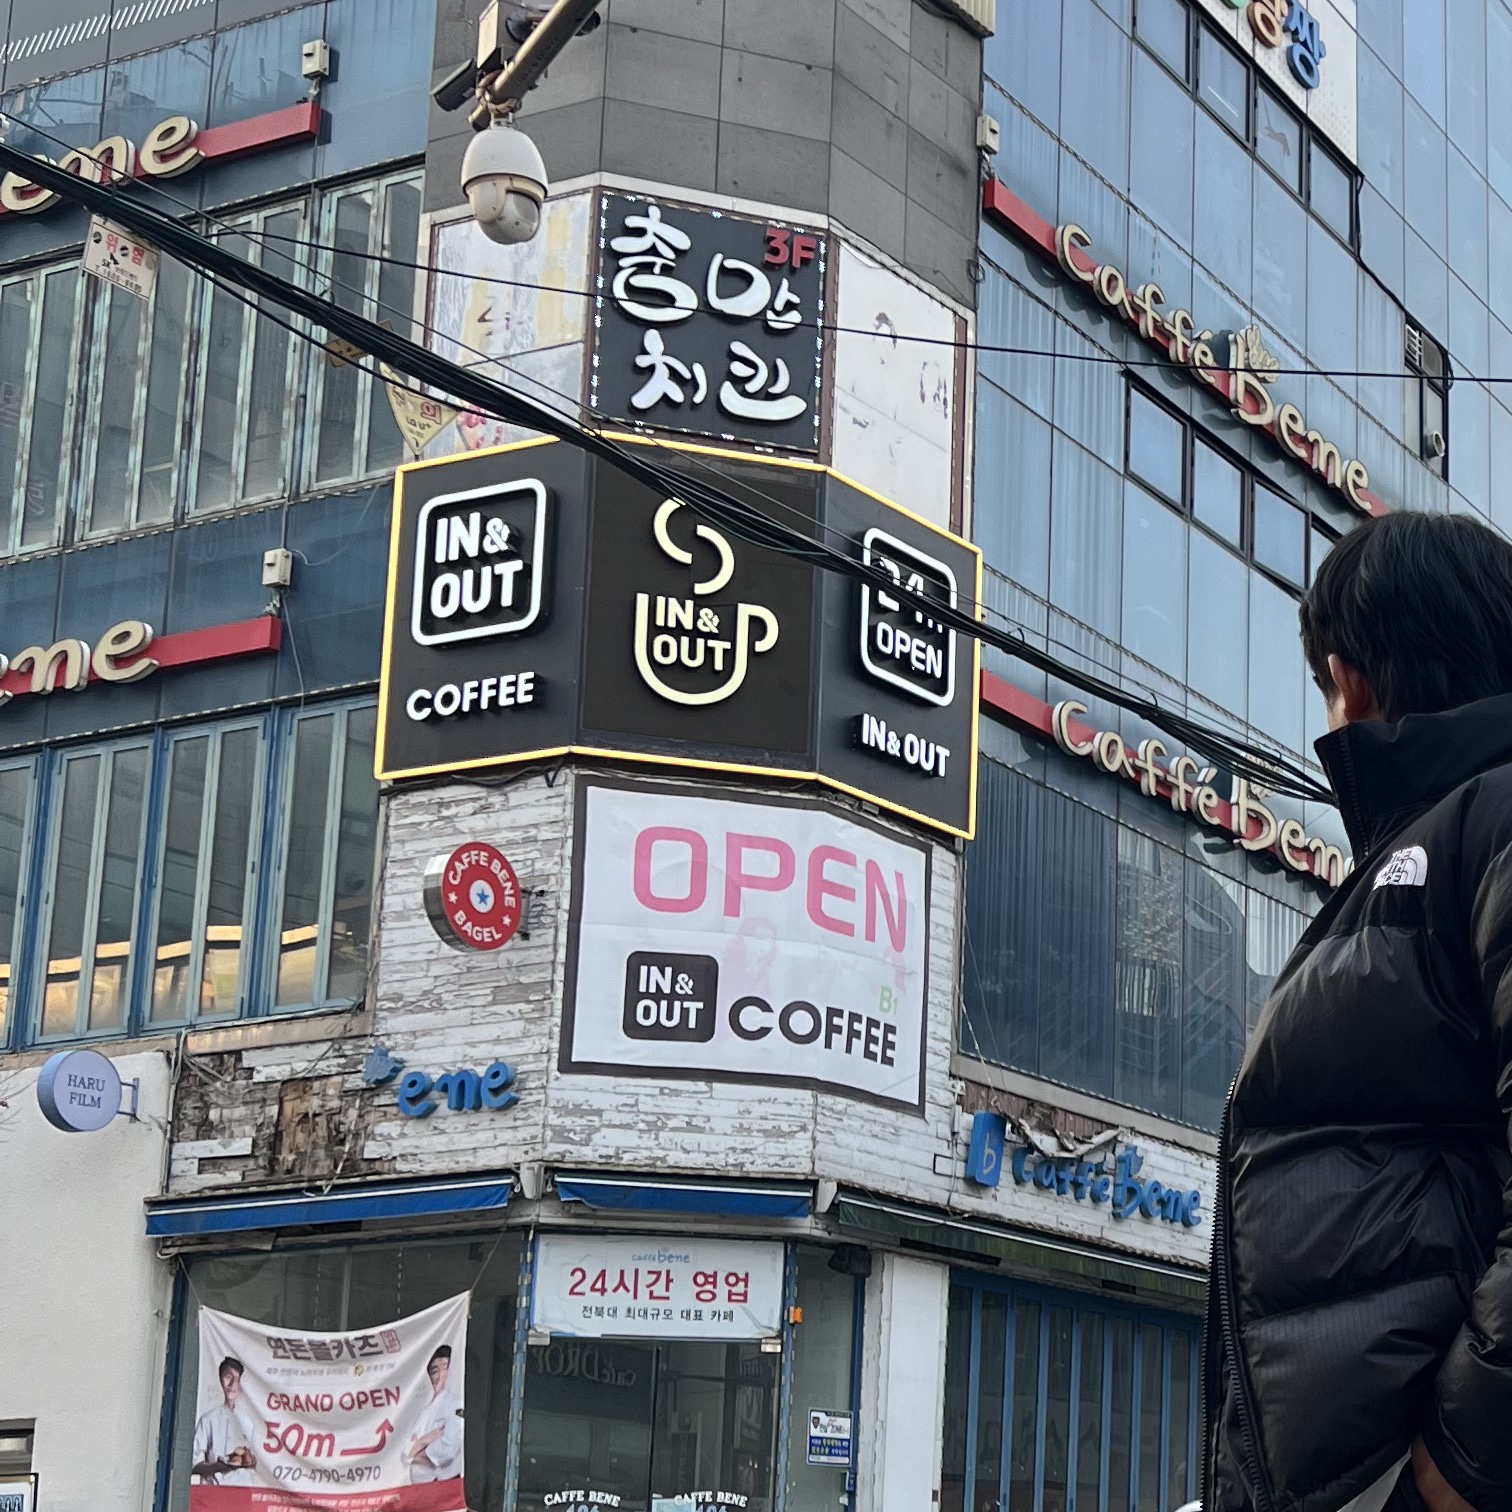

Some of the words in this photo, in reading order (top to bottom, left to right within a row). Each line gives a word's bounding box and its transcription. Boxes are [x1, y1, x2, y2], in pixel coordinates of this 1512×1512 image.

[610, 203, 802, 332] 충만
[764, 227, 817, 269] 3F
[630, 328, 808, 421] 치킨
[434, 512, 511, 564] IN&
[430, 560, 524, 620] OUT
[655, 596, 721, 634] IN&
[653, 633, 731, 671] OUT
[876, 621, 944, 679] OPEN
[405, 671, 536, 722] COFFEE
[448, 850, 490, 886] CAFFE
[490, 858, 517, 909] BENE
[632, 825, 907, 955] OPEN
[453, 910, 503, 943] BAGEL
[638, 964, 696, 996] IN&
[634, 997, 705, 1030] OUT
[728, 996, 899, 1067] COFFEE
[67, 1073, 106, 1092] HARU
[69, 1091, 102, 1109] FILM
[568, 1266, 675, 1302] 24시간
[692, 1270, 751, 1304] 영업
[581, 1305, 618, 1319] 전북대
[625, 1306, 674, 1321] 최대규모
[680, 1309, 704, 1322] 대표
[710, 1309, 735, 1323] 카페
[266, 1391, 335, 1413] GRAND
[338, 1386, 401, 1412] OPEN
[263, 1420, 336, 1458] 50m
[272, 1464, 382, 1484] 070-4790-4970
[543, 1489, 586, 1506] CAFFE
[588, 1490, 621, 1508] BENE
[717, 1490, 749, 1508] BENE
